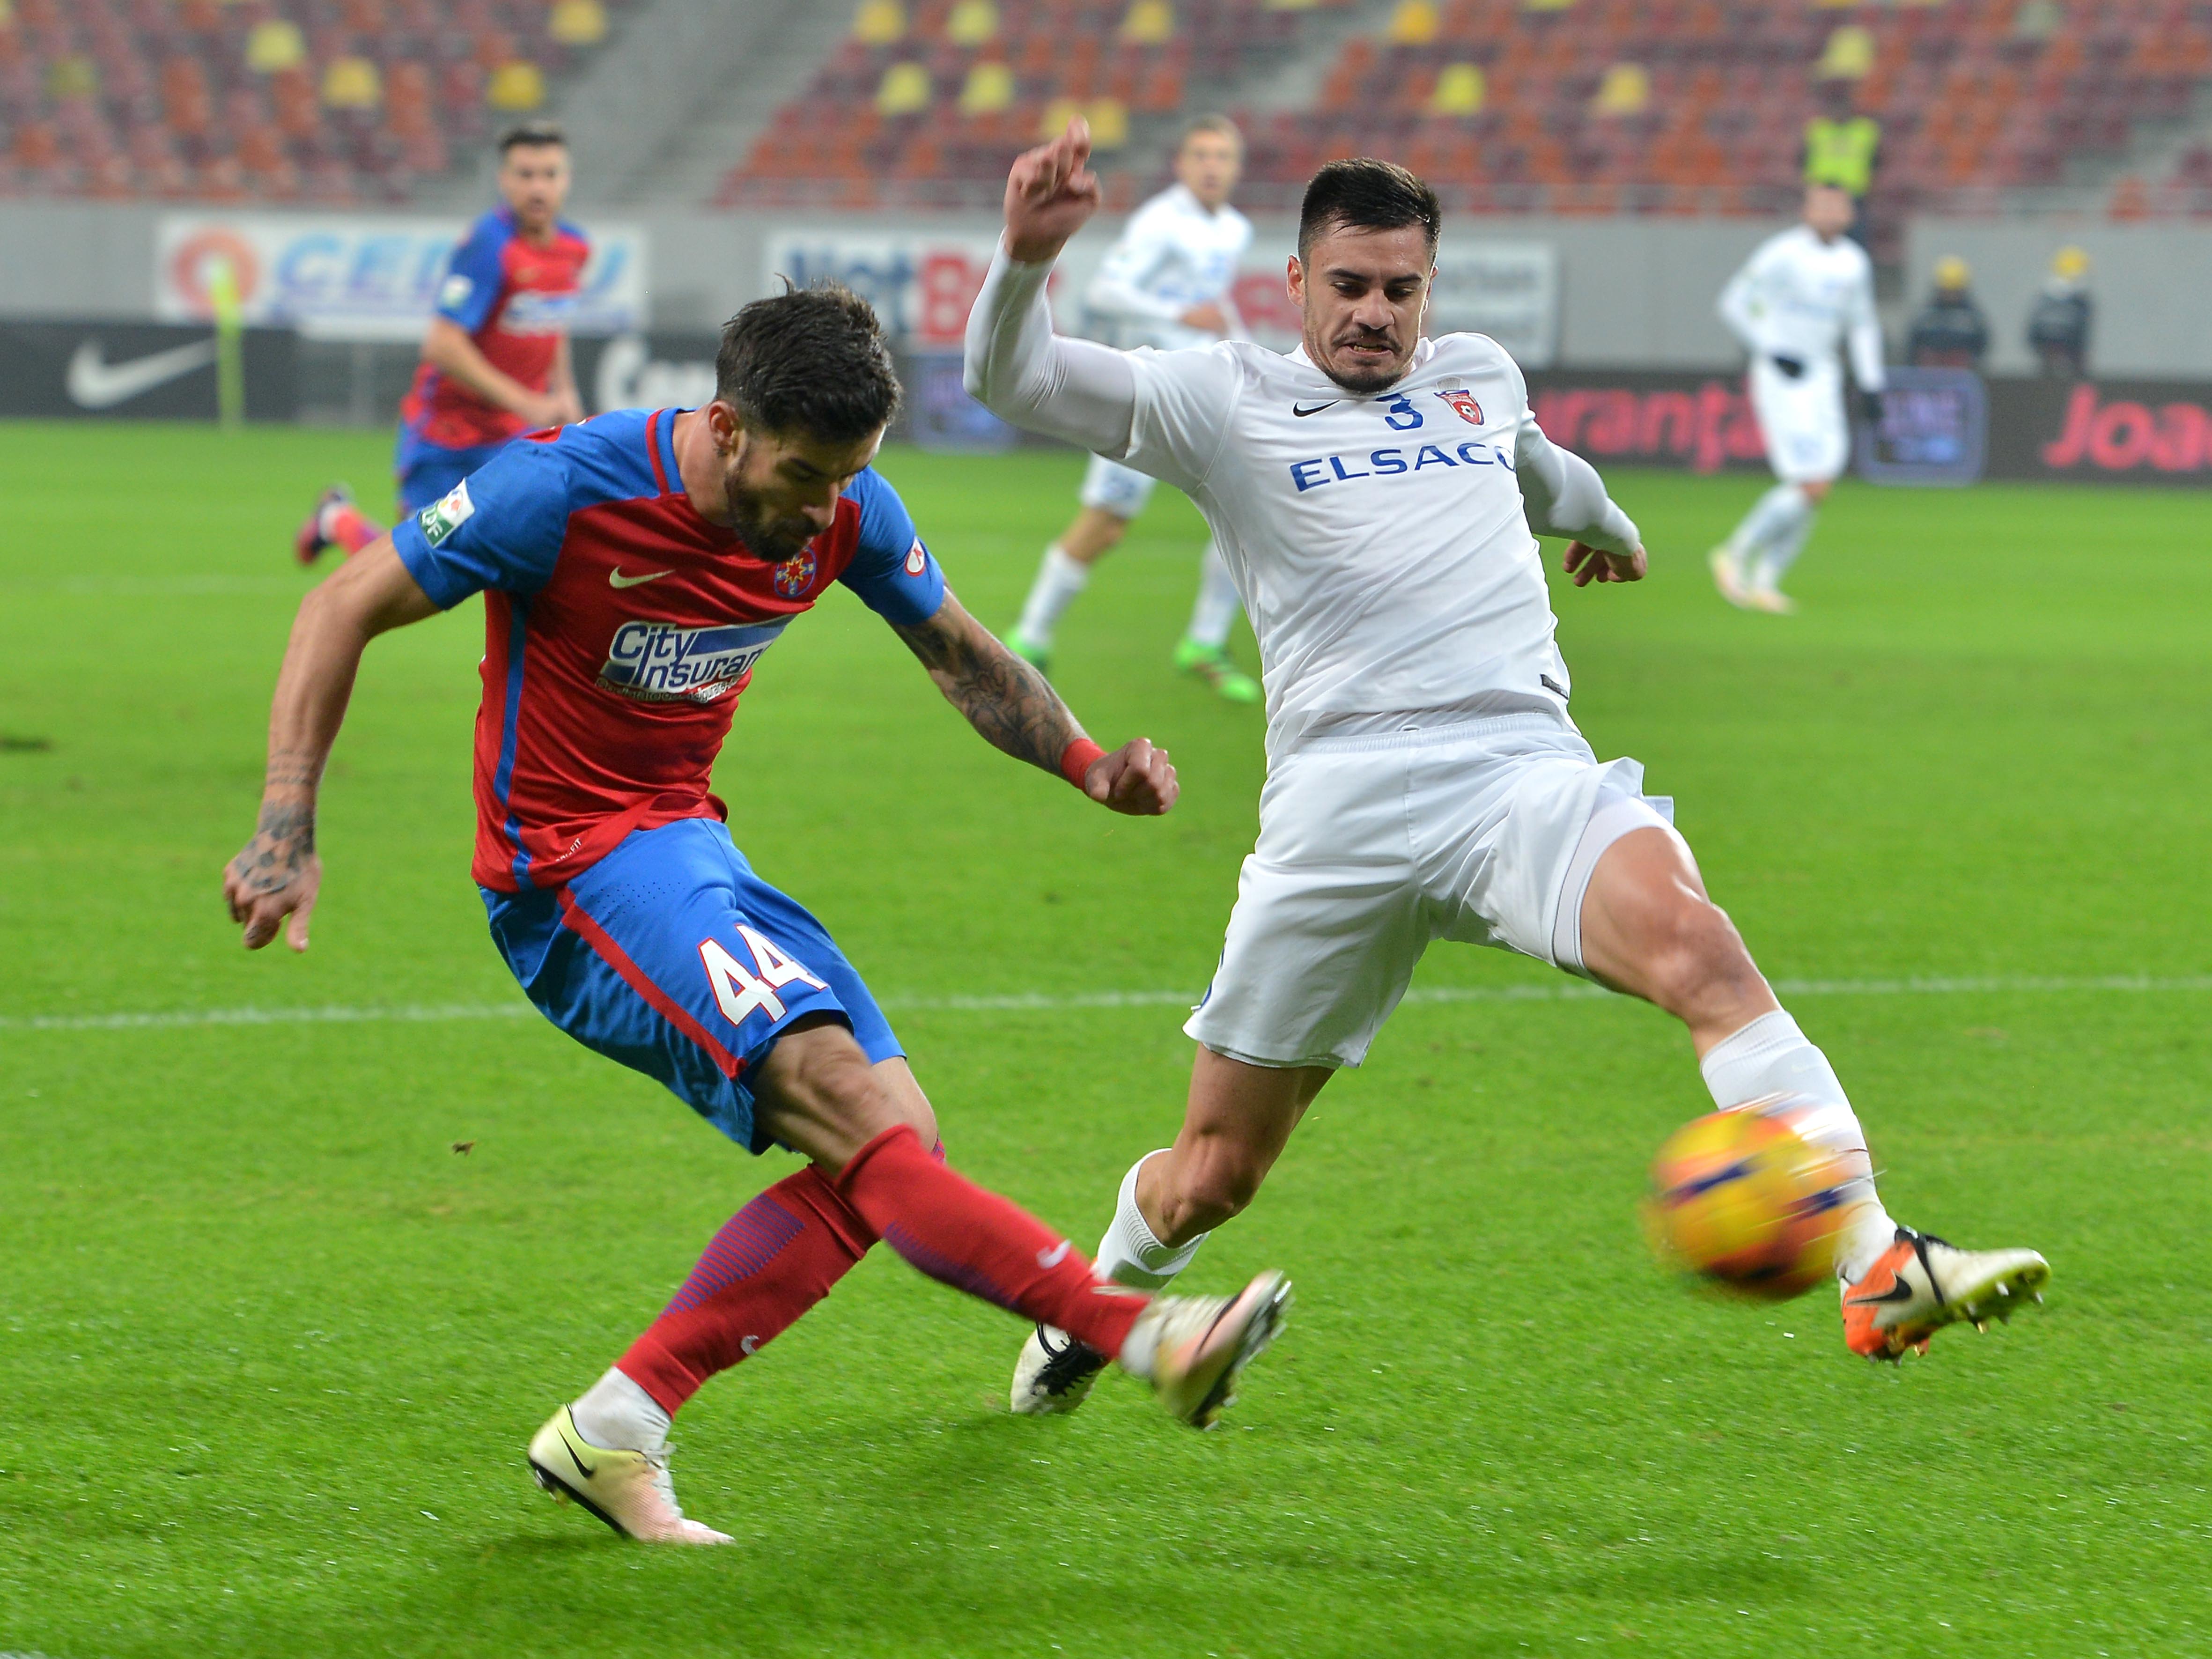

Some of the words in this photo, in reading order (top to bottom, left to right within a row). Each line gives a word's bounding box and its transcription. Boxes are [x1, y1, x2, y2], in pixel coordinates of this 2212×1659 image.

[1375, 393, 1423, 430] 3
[2042, 383, 2212, 471] Joa
[612, 624, 697, 670] City
[631, 646, 764, 689] Insuran
[697, 922, 830, 1027] 44
